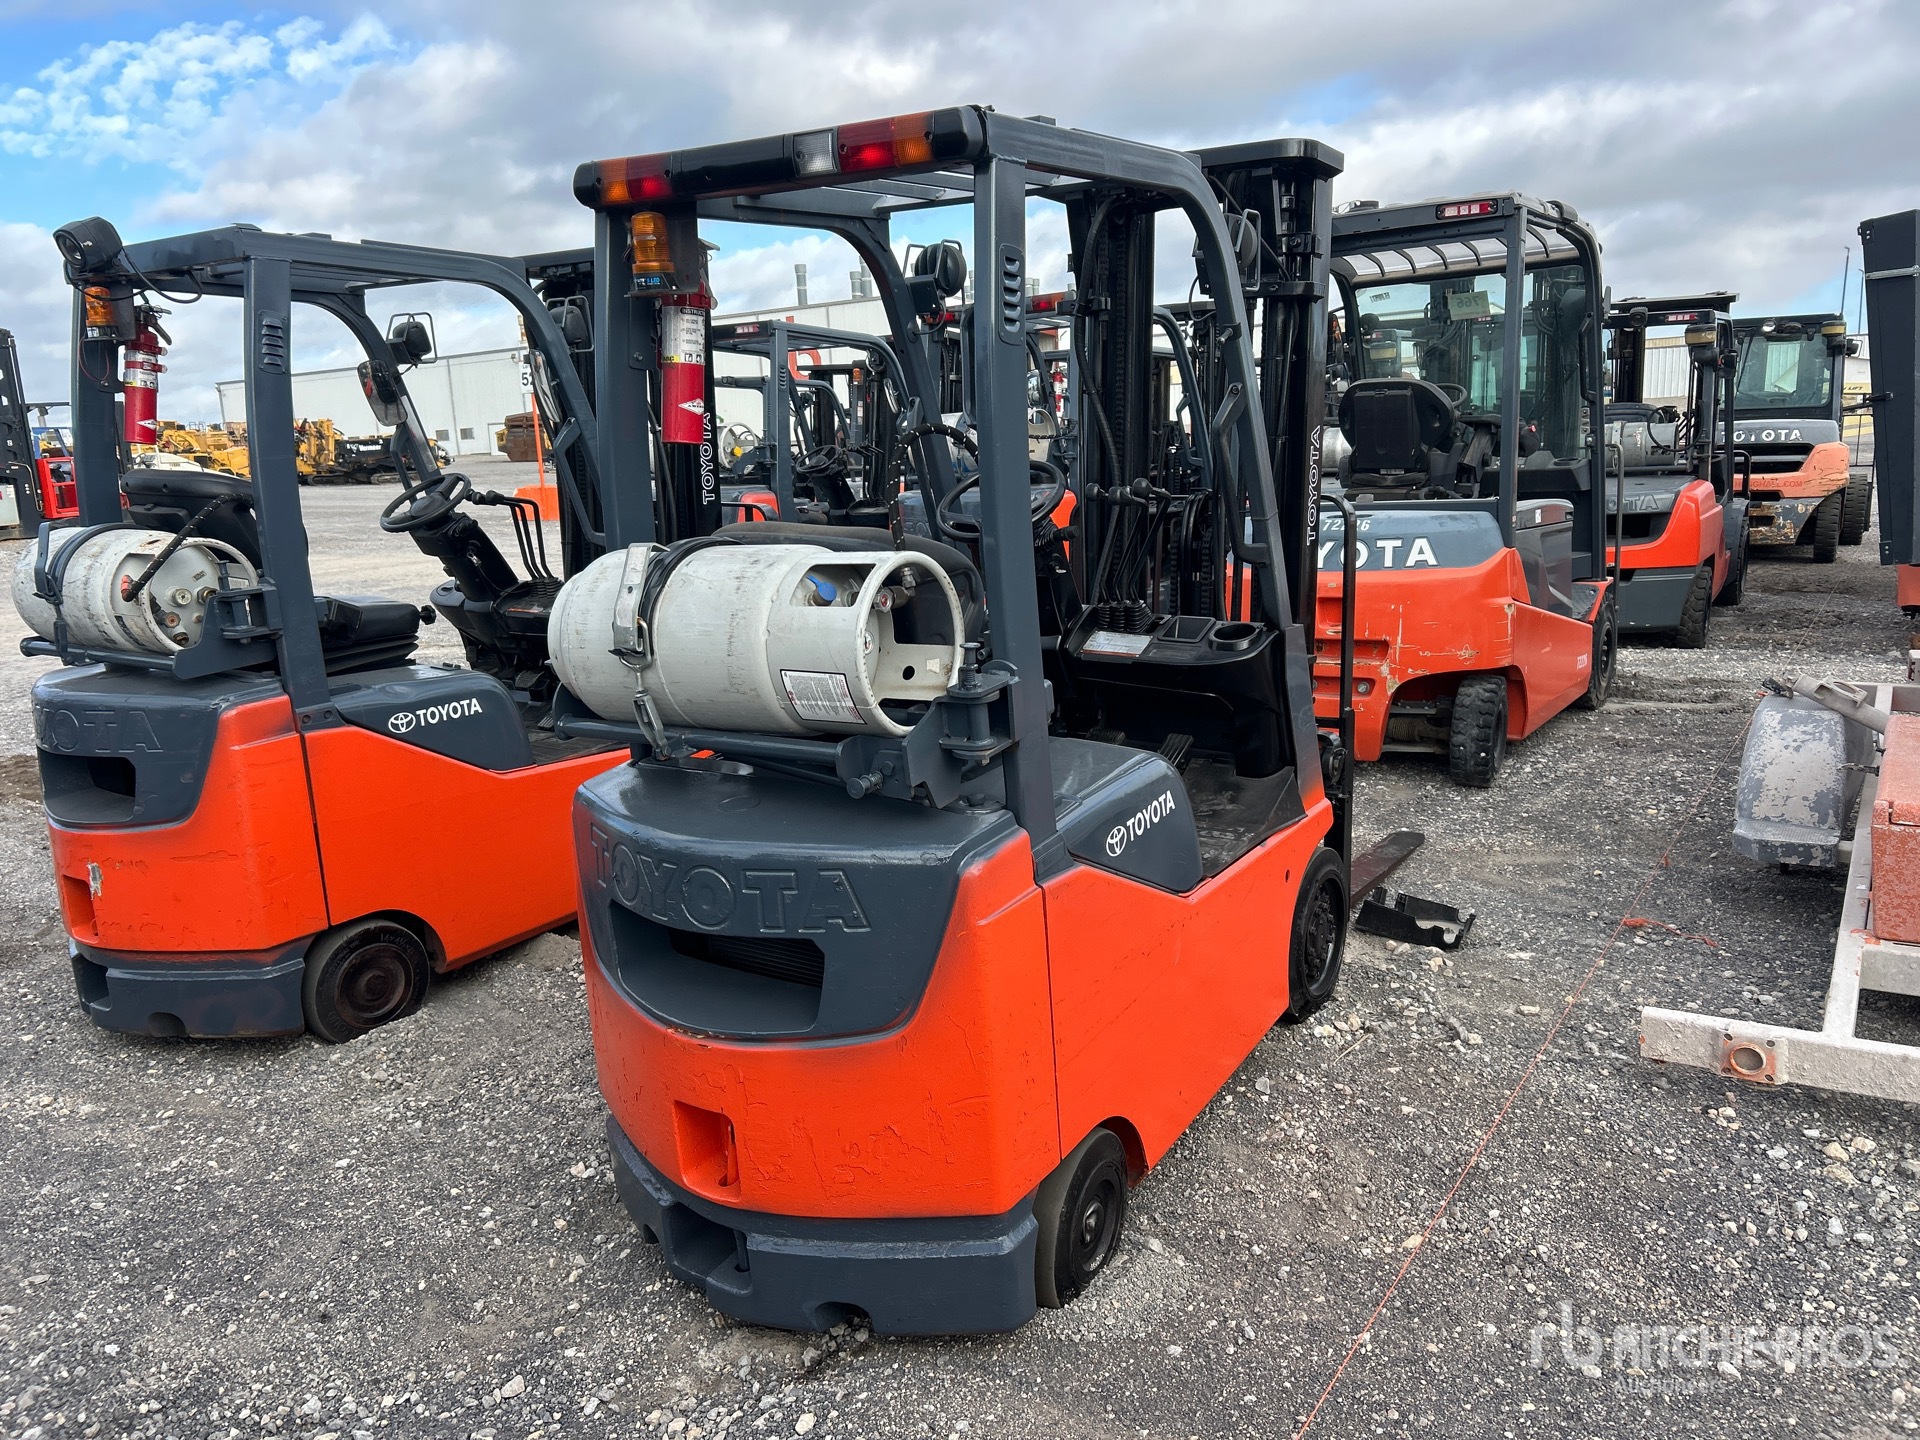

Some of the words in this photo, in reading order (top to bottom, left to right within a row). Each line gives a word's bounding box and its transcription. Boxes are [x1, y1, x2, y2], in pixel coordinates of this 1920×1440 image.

[1306, 425, 1321, 546] TOYOTA
[1605, 494, 1659, 512] OTA
[1323, 519, 1371, 531] 726
[1318, 537, 1440, 569] YOTA
[416, 698, 482, 727] TOYOTA
[1126, 790, 1176, 842] TOYOTA
[590, 822, 872, 933] TOYOTA
